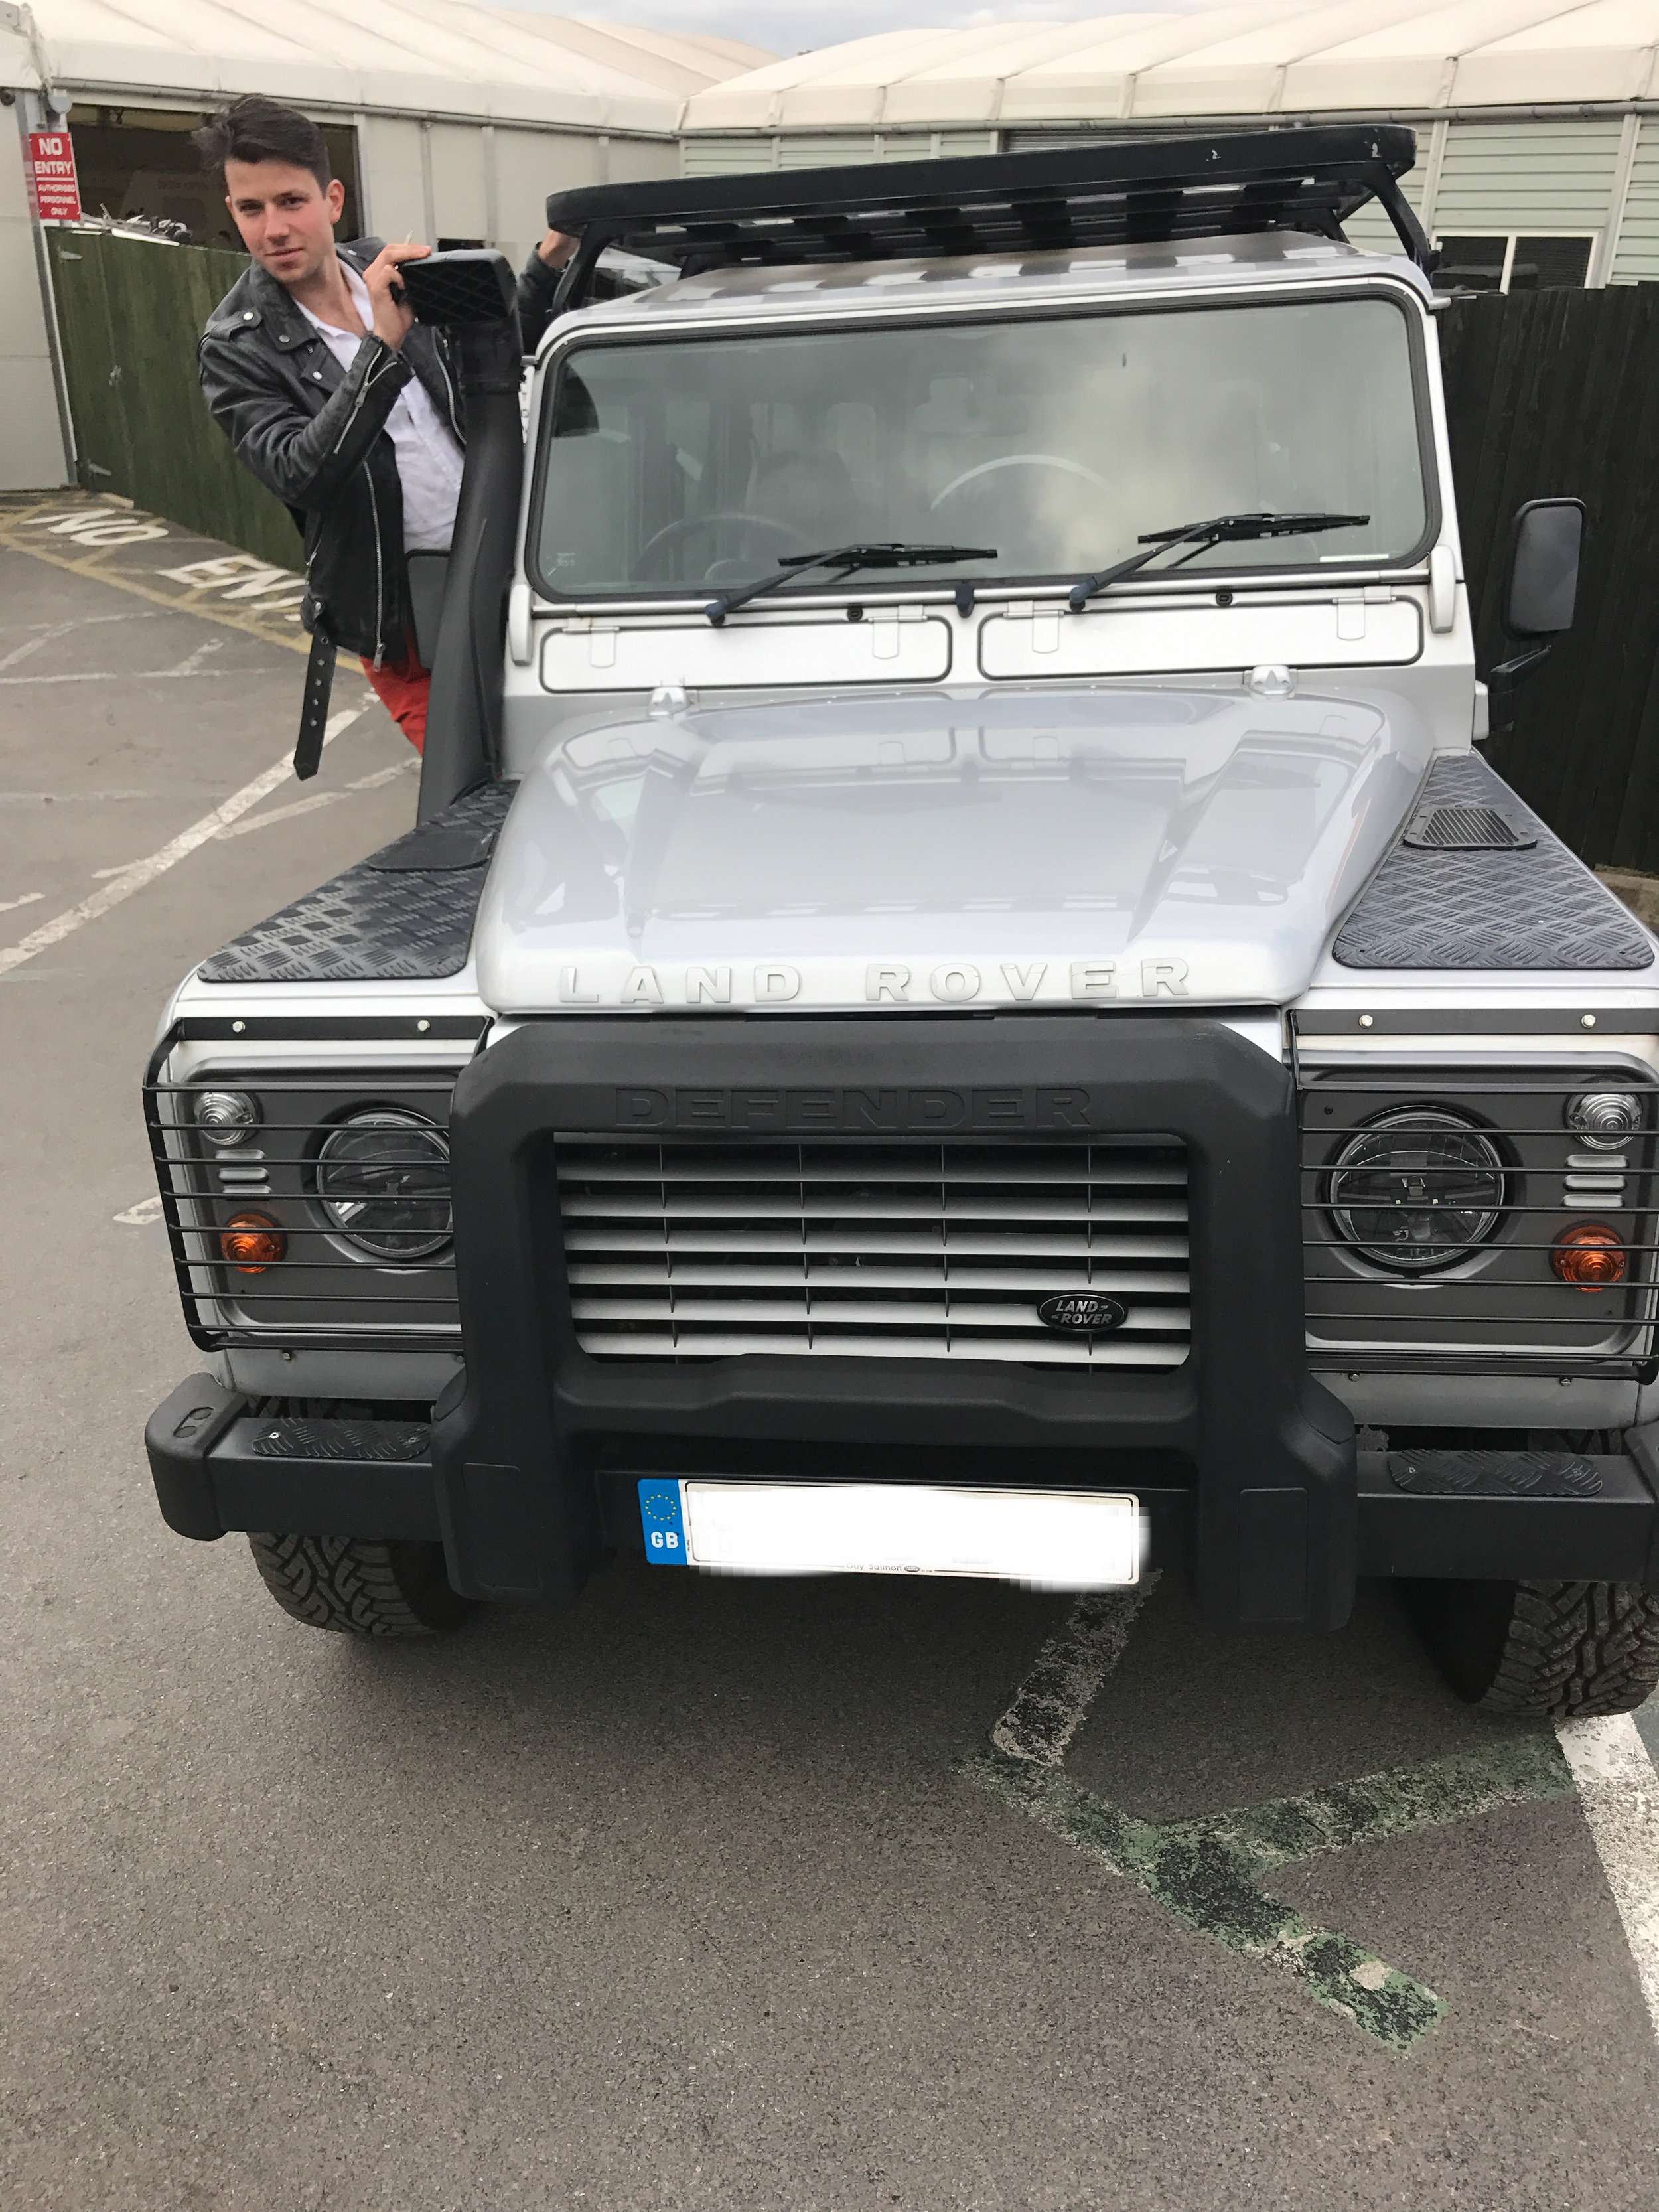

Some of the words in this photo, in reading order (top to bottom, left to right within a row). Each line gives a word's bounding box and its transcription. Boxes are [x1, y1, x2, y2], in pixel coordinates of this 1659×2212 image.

[38, 137, 63, 155] NO
[34, 161, 72, 175] ENTRY
[20, 508, 169, 546] NO
[559, 964, 800, 1004] LAND
[865, 958, 1190, 1001] ROVER
[614, 1086, 1092, 1129] DEFENDER
[650, 1531, 678, 1549] GB
